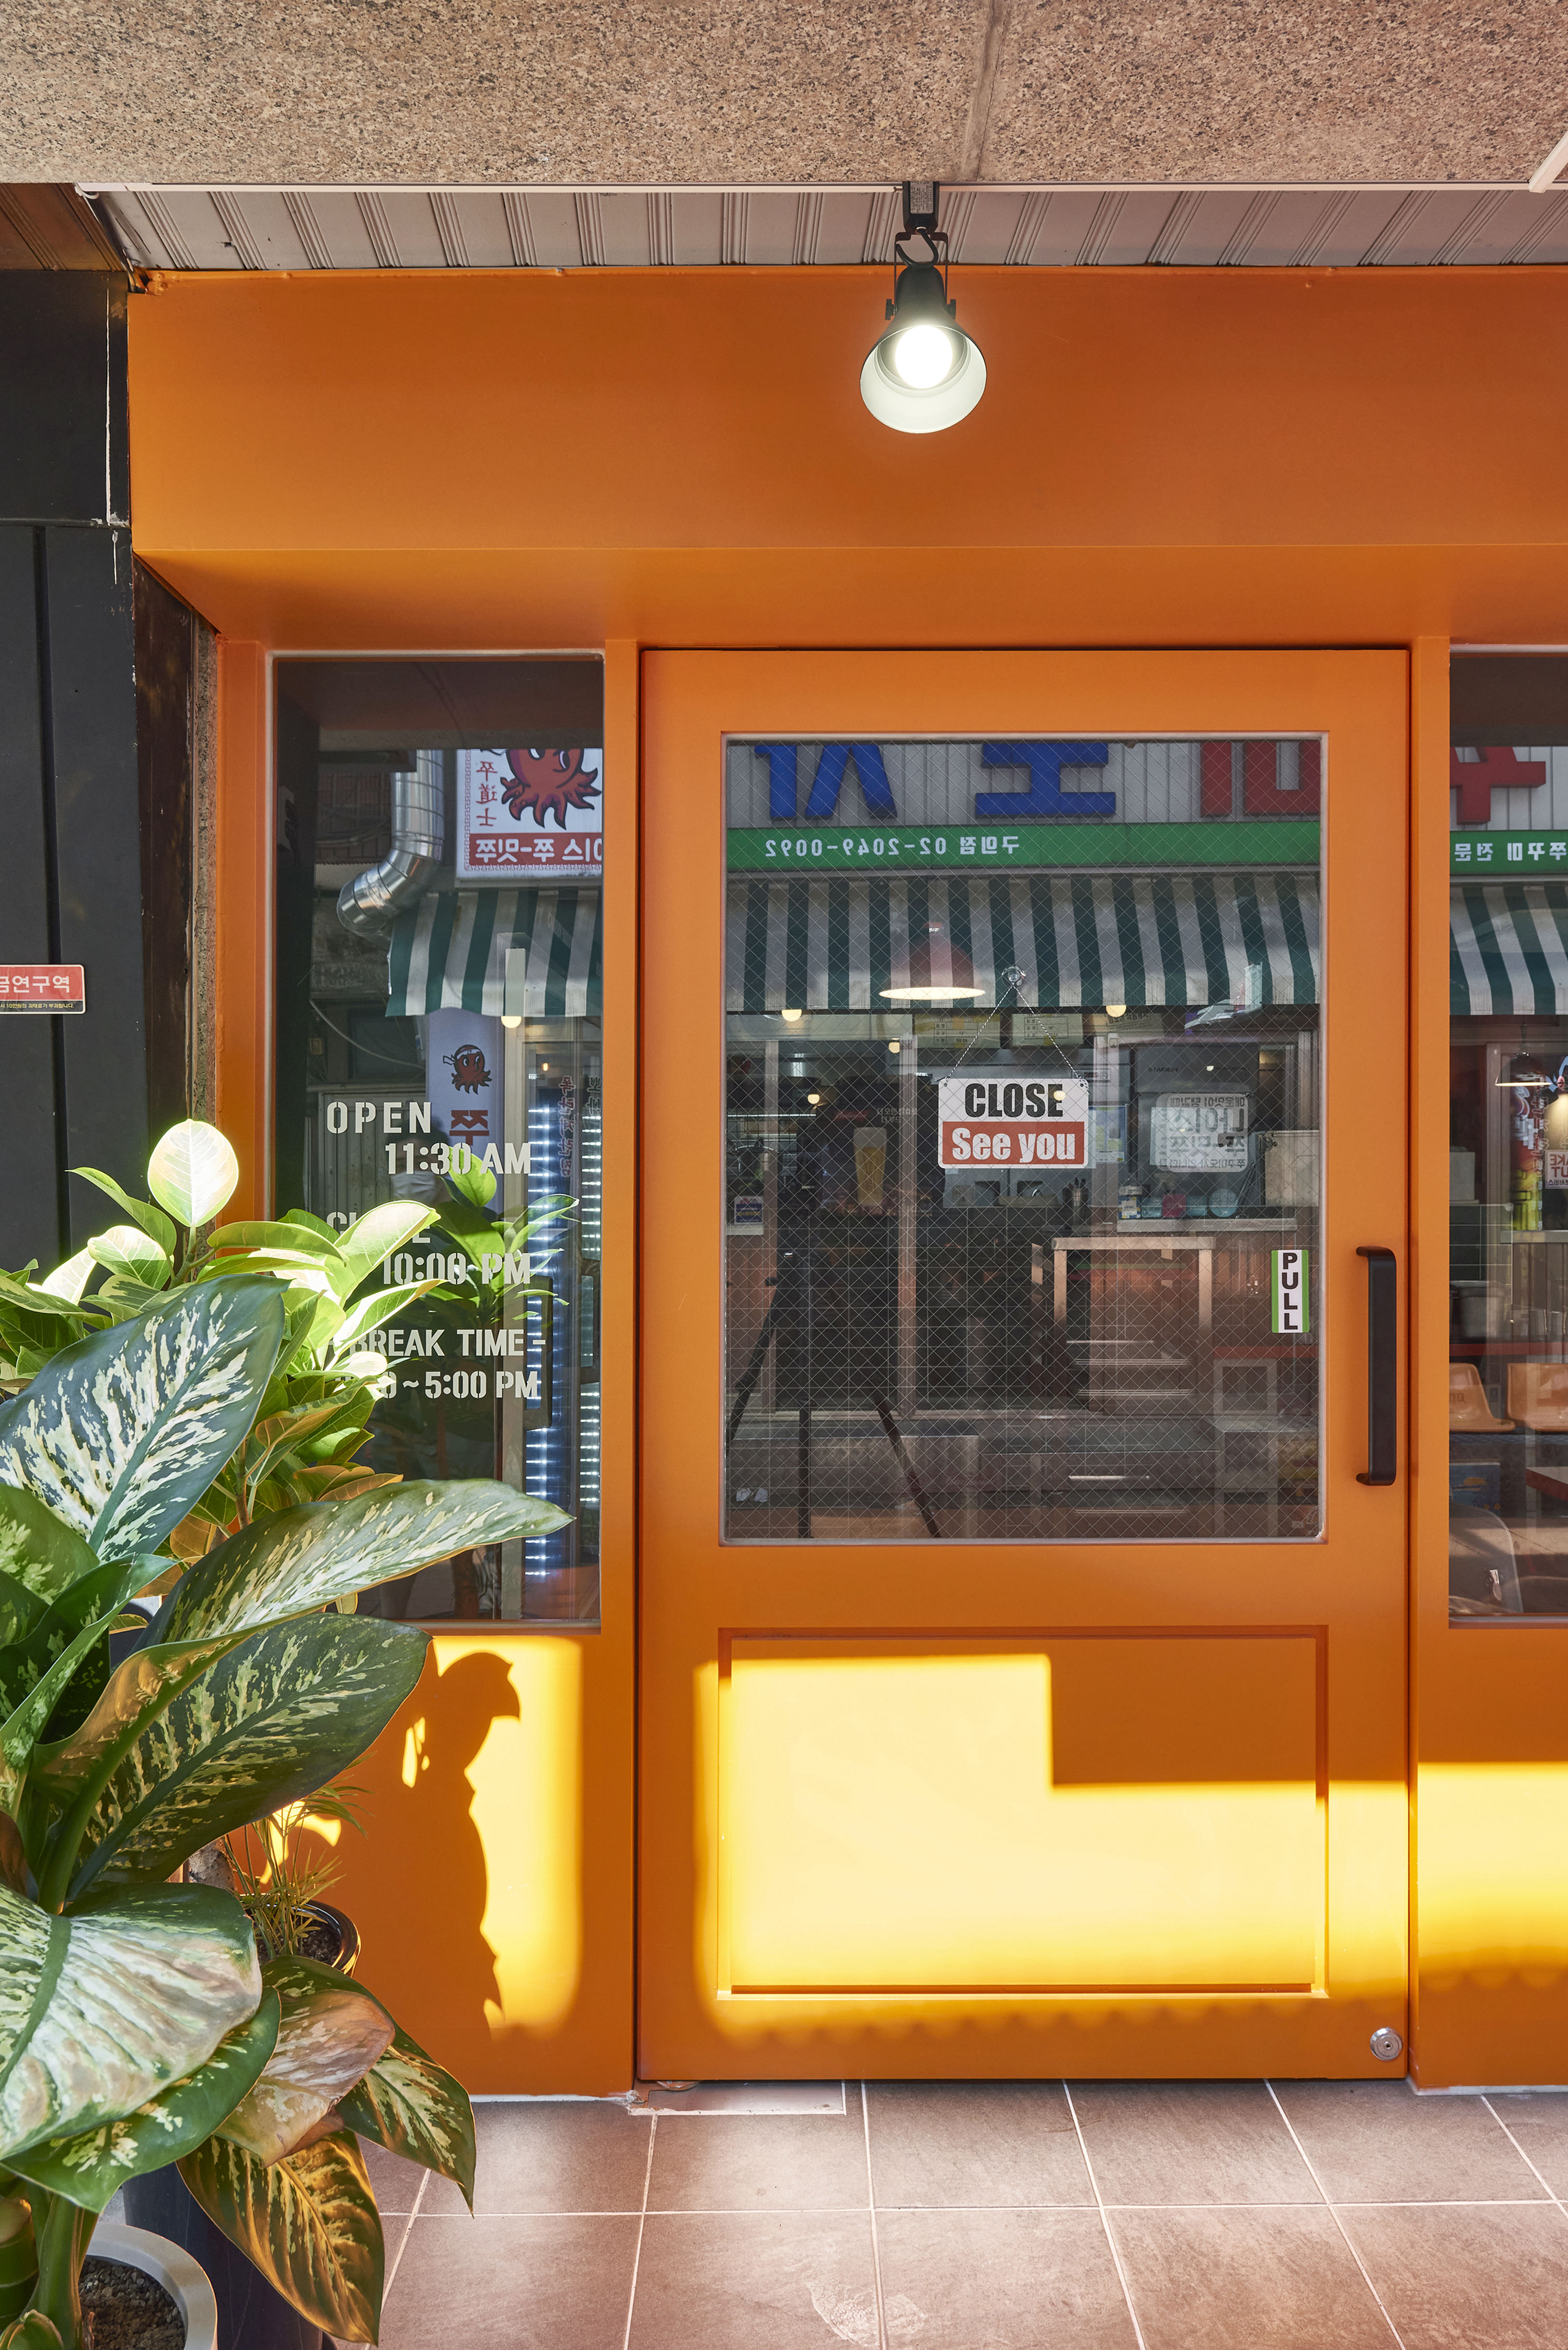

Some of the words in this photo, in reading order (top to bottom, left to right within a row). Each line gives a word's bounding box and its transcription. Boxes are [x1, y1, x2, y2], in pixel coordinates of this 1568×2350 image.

[965, 1083, 1063, 1117] CLOSE
[327, 1102, 431, 1134] OPEN
[385, 1142, 471, 1175] 11:30
[480, 1143, 531, 1174] AM
[952, 1127, 1011, 1160] See
[1018, 1133, 1075, 1163] you
[383, 1253, 466, 1285] 10:00
[482, 1253, 531, 1285] PM
[1282, 1253, 1299, 1330] PULL
[457, 1329, 524, 1356] TIME
[495, 1371, 538, 1398] PM
